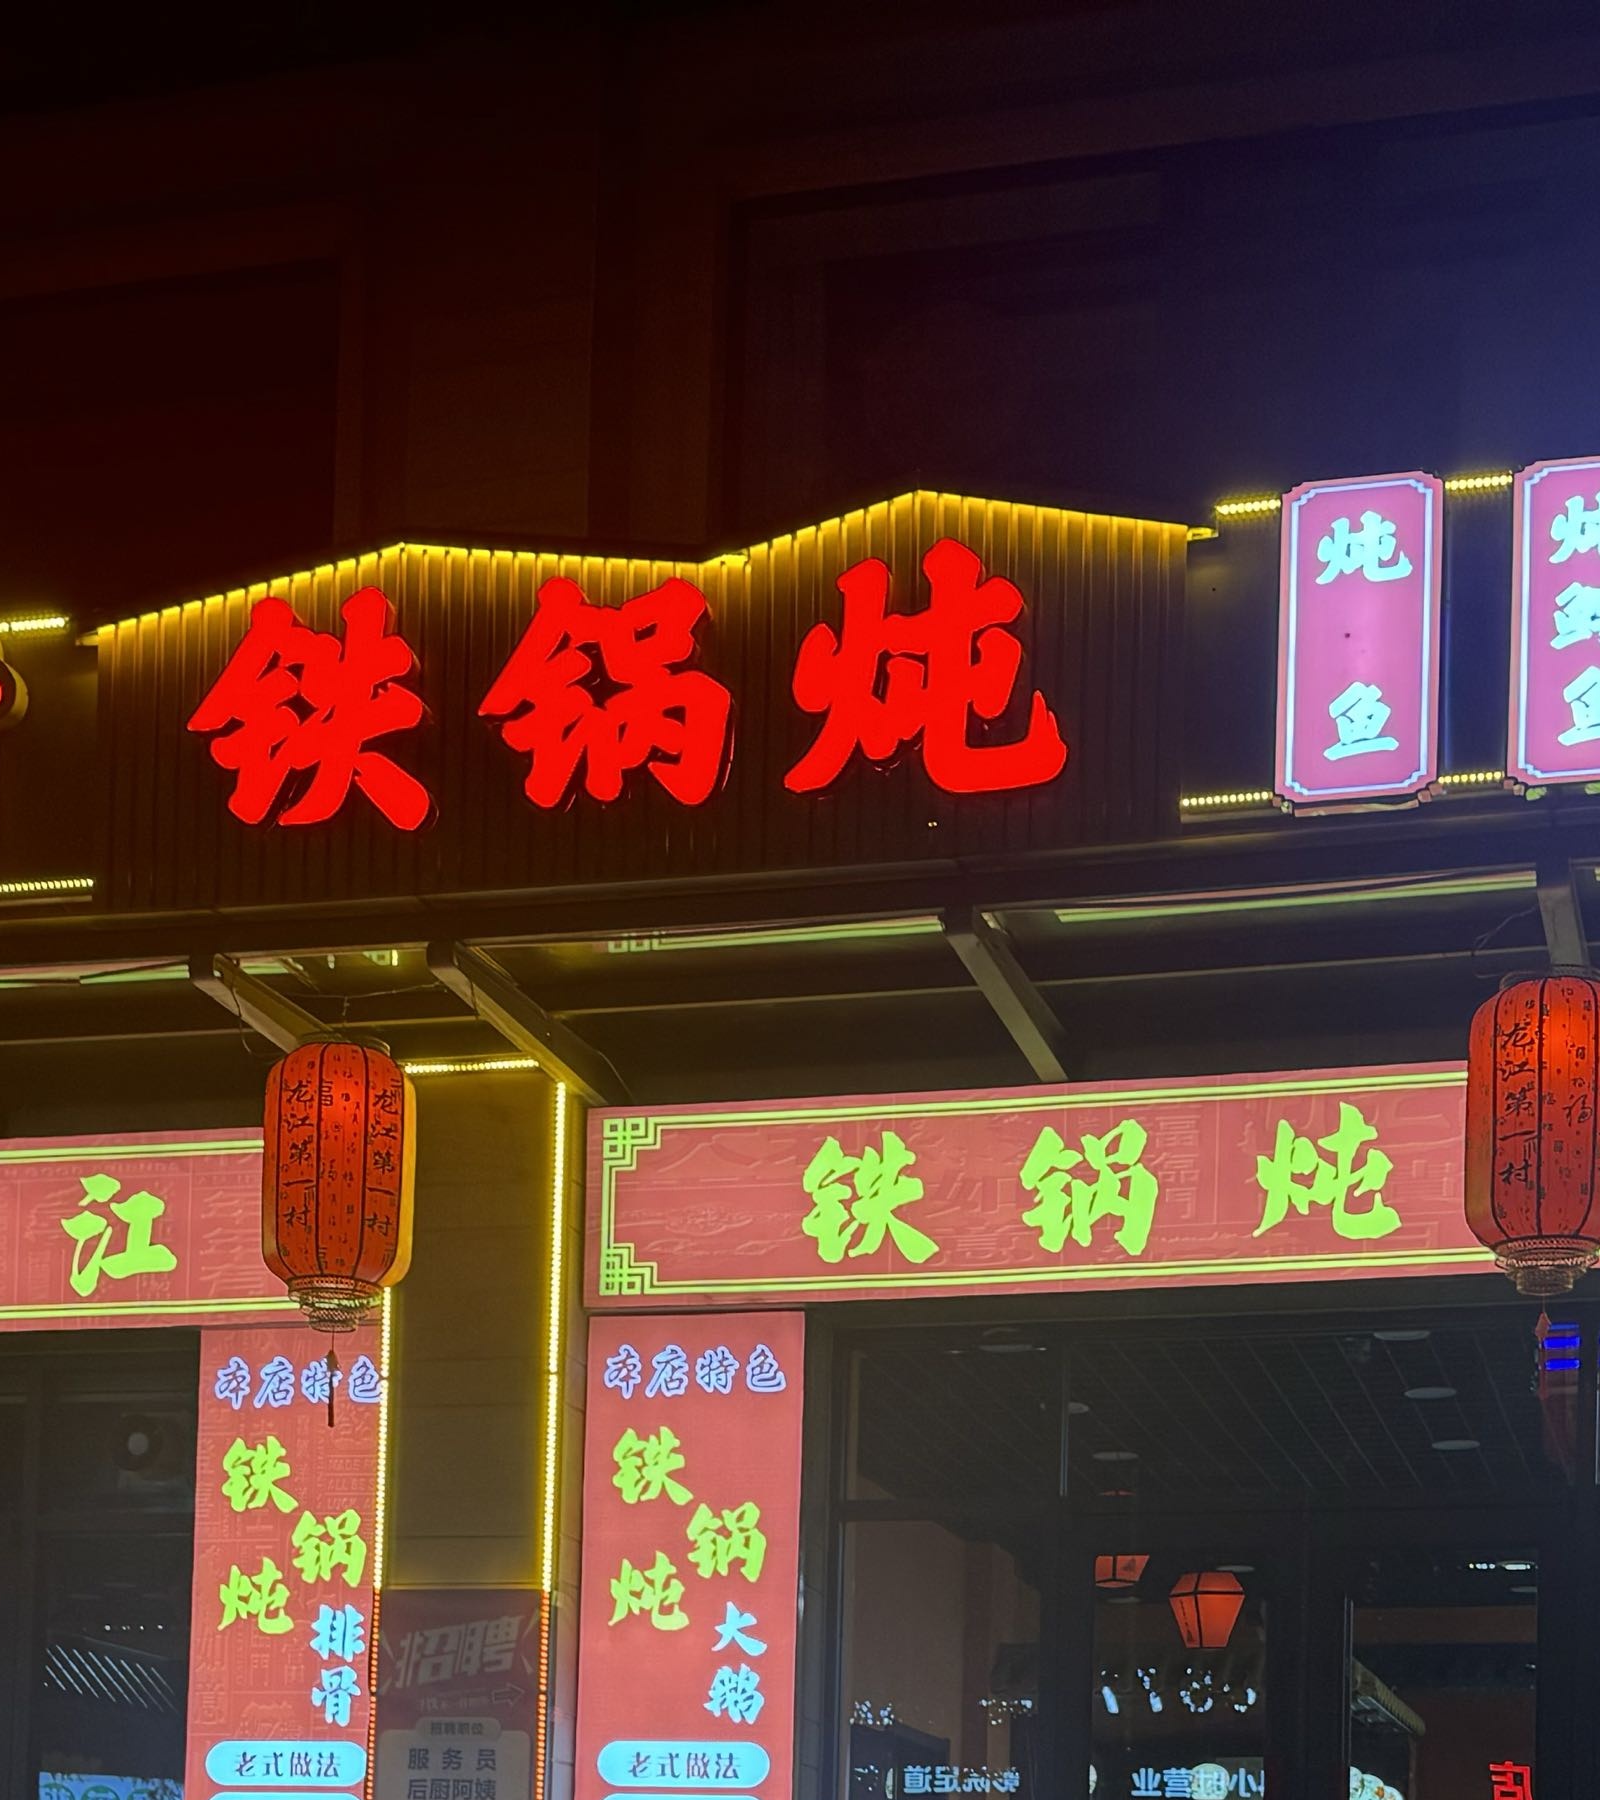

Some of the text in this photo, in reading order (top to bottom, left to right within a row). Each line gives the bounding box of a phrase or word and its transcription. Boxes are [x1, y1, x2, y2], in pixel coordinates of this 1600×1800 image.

[187, 537, 1068, 830] 铁锅炖
[1315, 510, 1413, 761] 炖鱼
[282, 1078, 315, 1228] 龙江第一村
[365, 1087, 399, 1238] 龙江第一村
[1498, 1021, 1535, 1186] 龙江第一村
[214, 1355, 384, 1410] 本店特色
[603, 1343, 787, 1400] 本店特色
[217, 1434, 368, 1635] 铁锅炖
[607, 1425, 768, 1632] 铁锅炖
[311, 1603, 366, 1728] 排骨
[395, 1613, 527, 1690] 招聘
[703, 1600, 768, 1726] 大鹅
[234, 1751, 342, 1779] 老式做法
[407, 1748, 498, 1772] 服务员
[627, 1751, 742, 1780] 老式做法
